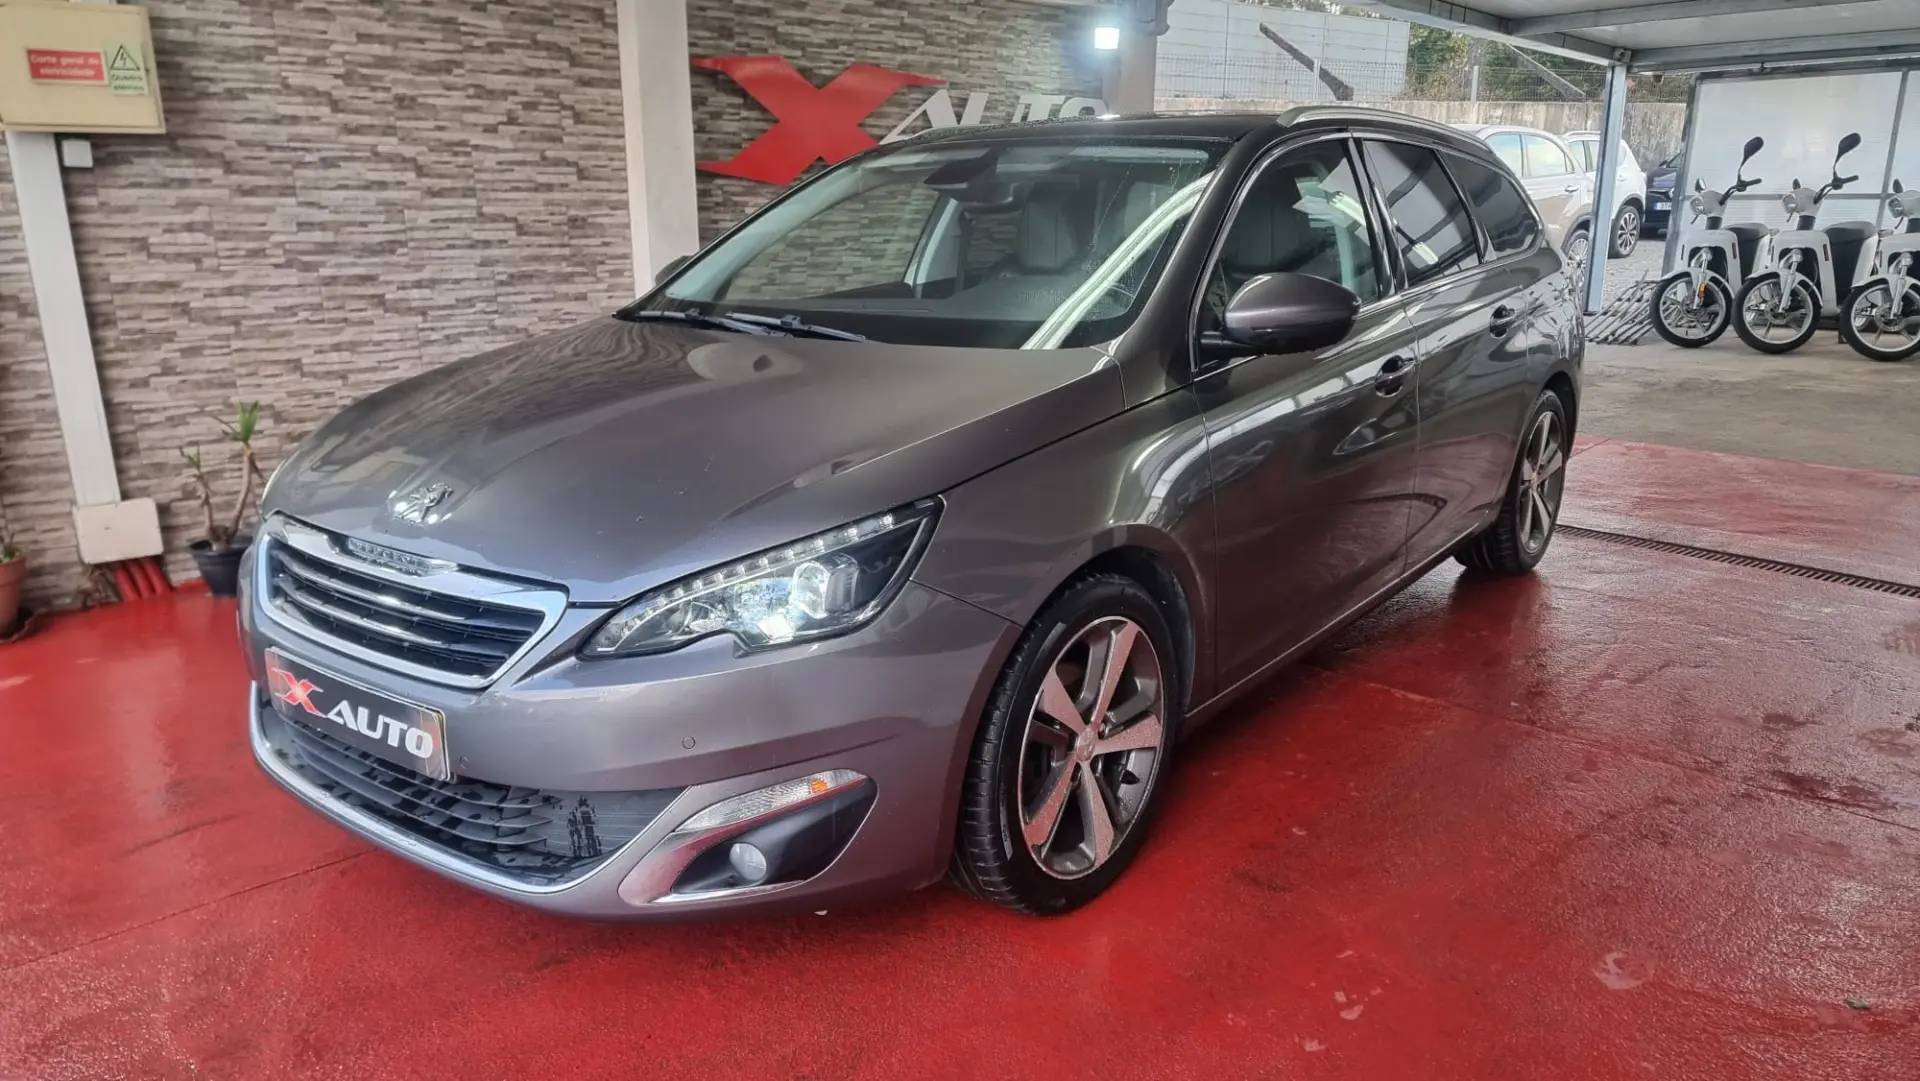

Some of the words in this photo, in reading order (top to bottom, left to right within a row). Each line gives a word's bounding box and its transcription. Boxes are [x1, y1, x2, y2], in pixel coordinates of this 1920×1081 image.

[30, 54, 57, 64] Corte
[60, 56, 84, 66] geral
[691, 54, 947, 185] X
[271, 667, 327, 719] X
[325, 699, 434, 759] AUTO
